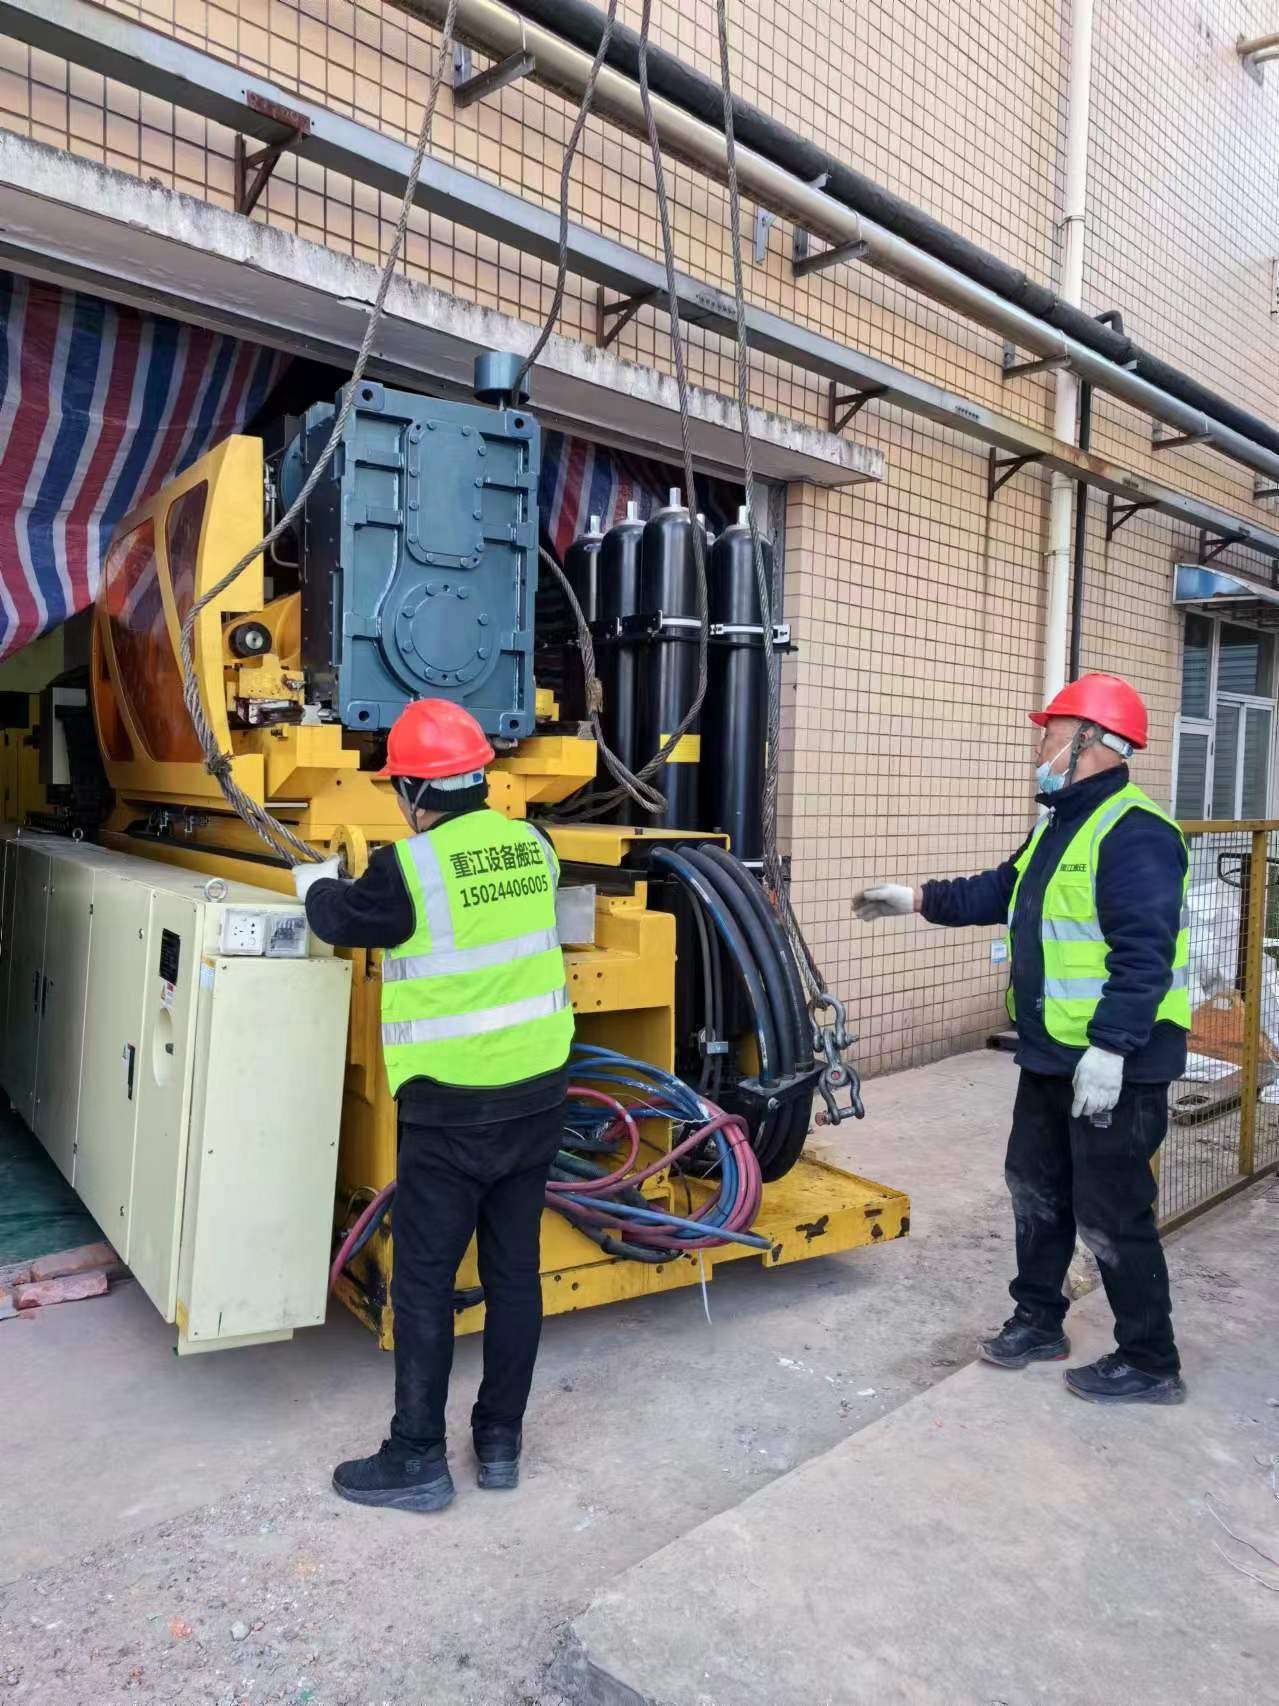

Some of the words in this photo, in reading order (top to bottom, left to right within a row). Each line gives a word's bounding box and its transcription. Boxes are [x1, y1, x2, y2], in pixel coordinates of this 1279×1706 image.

[450, 841, 543, 878] 重江设备搬迁
[460, 875, 548, 908] 15024406005
